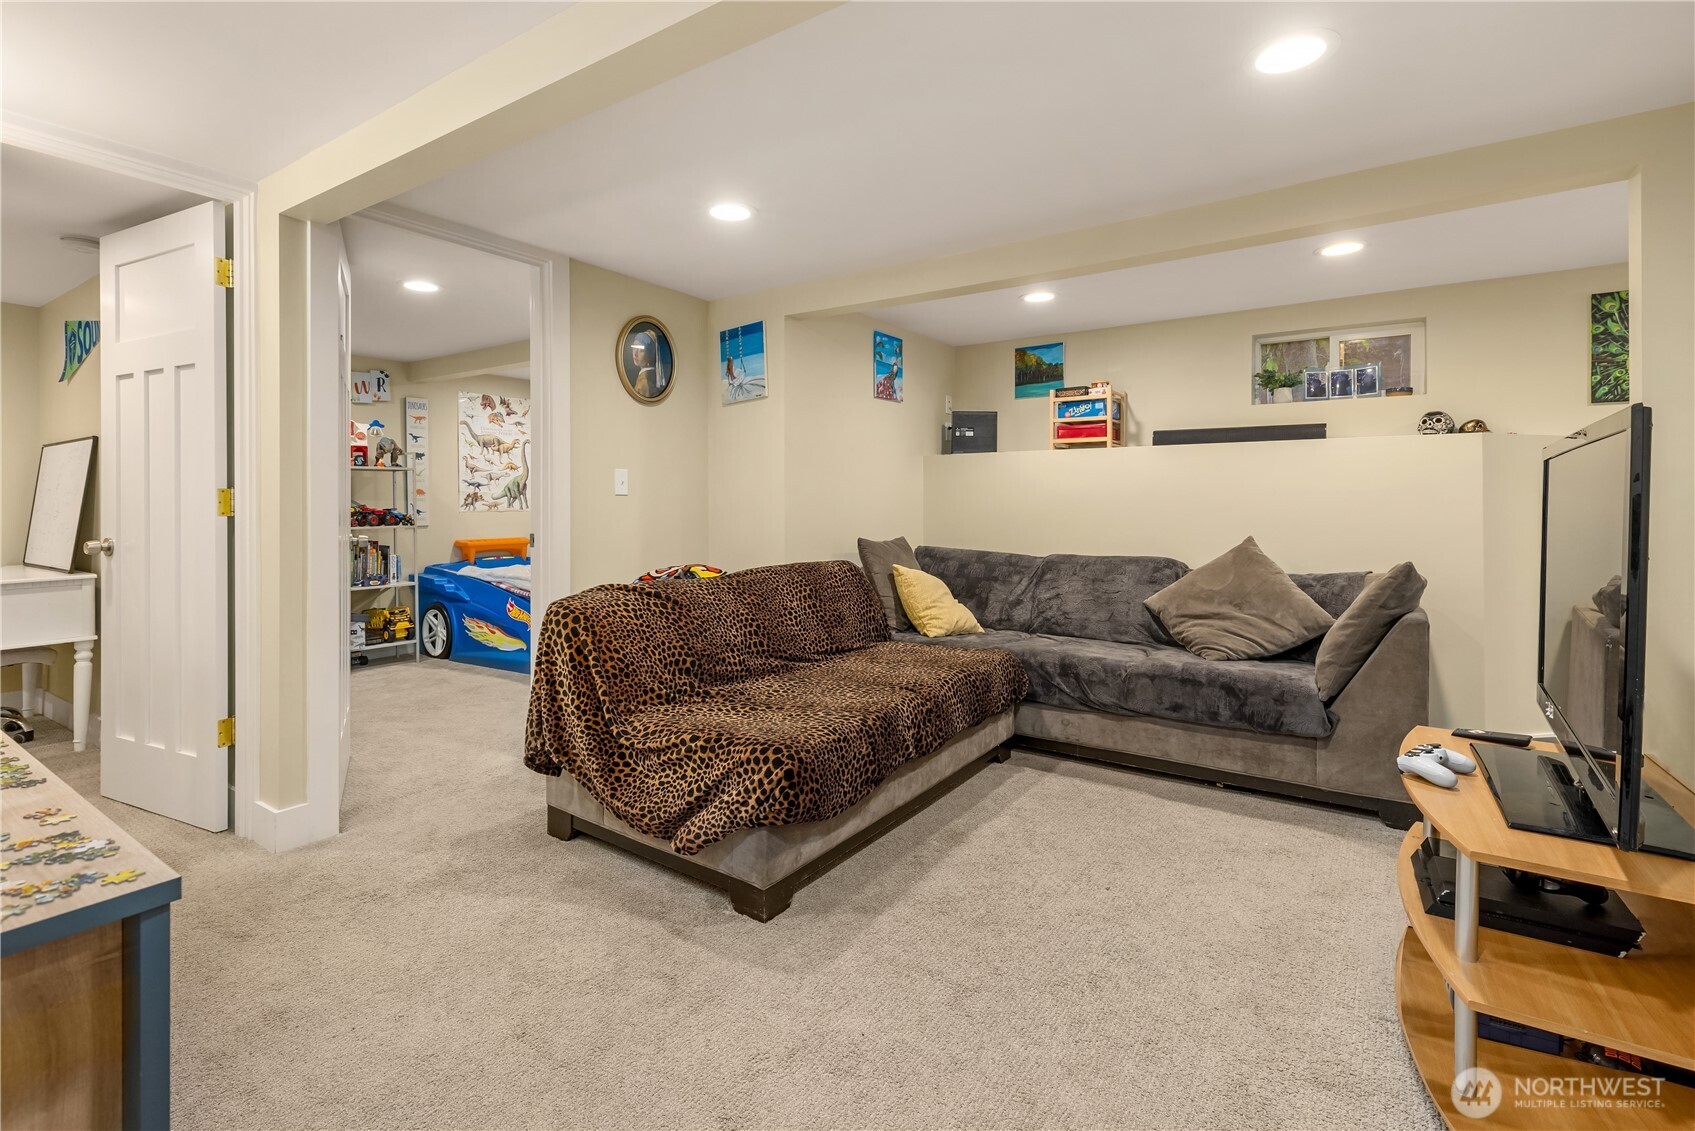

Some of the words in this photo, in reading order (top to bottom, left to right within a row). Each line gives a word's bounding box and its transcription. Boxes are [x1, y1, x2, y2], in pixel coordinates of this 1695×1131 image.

[77, 321, 100, 365] SOU
[354, 380, 370, 395] W
[376, 377, 386, 392] R
